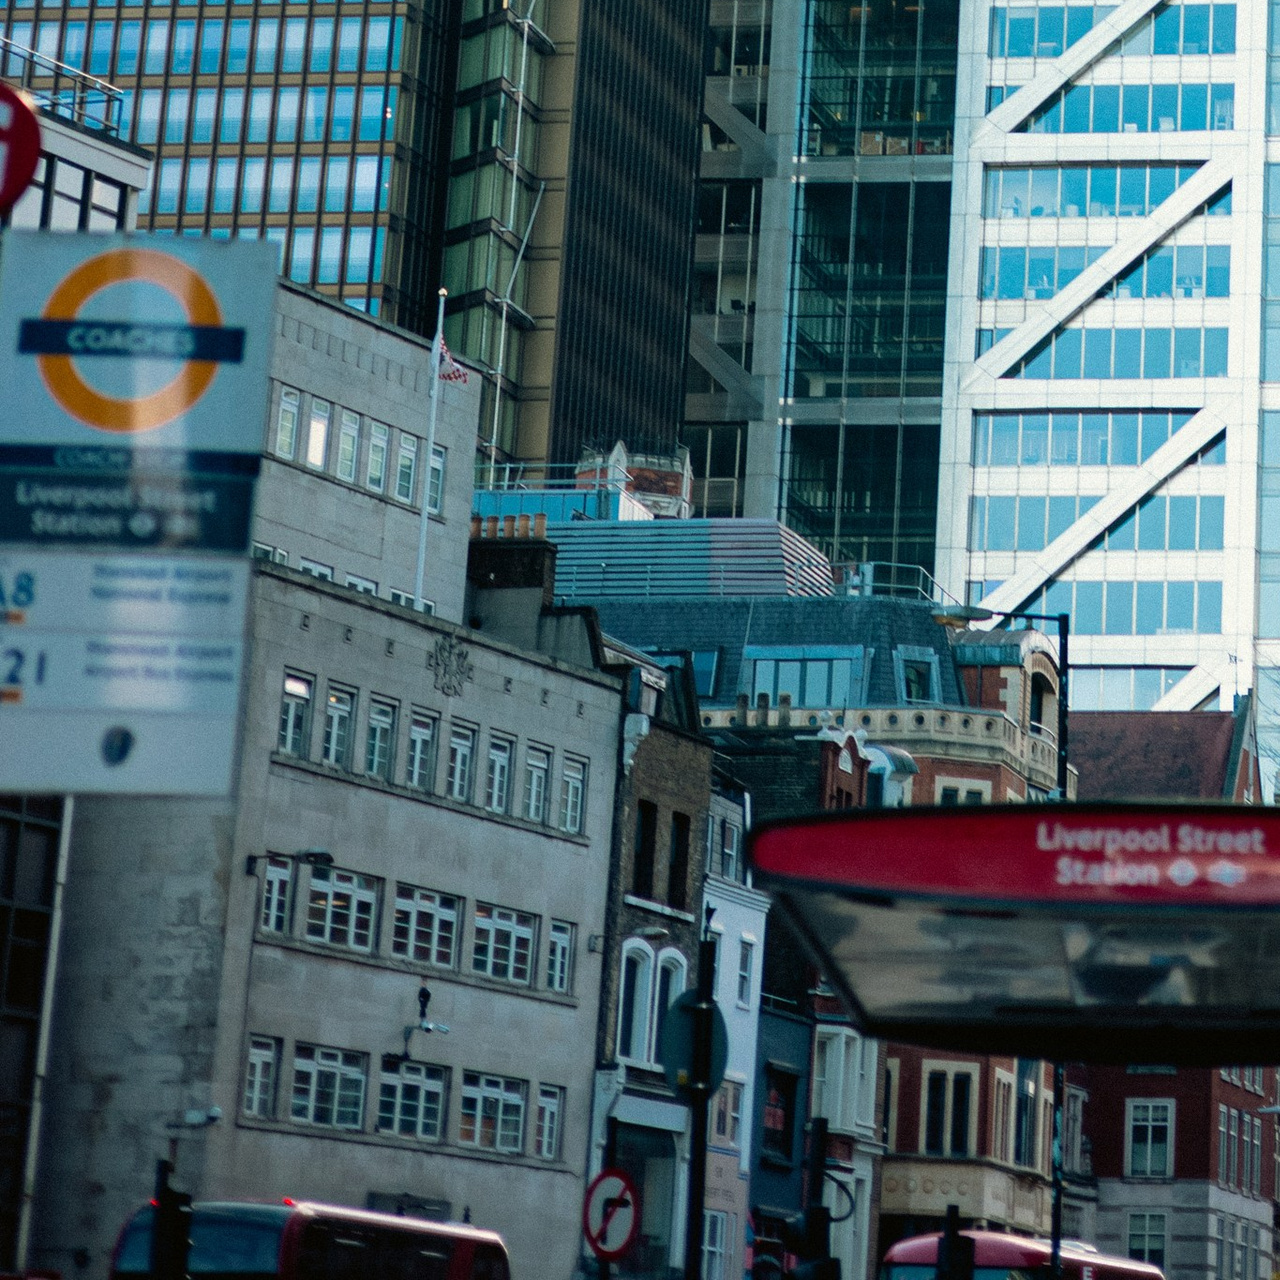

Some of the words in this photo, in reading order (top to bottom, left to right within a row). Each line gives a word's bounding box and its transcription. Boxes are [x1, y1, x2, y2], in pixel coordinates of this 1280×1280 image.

[67, 325, 195, 356] COACHES
[16, 480, 133, 513] Liverpool
[31, 510, 123, 536] Station
[1036, 821, 1170, 859] Liverpool
[1177, 823, 1266, 855] Street
[1056, 856, 1161, 887] Station
